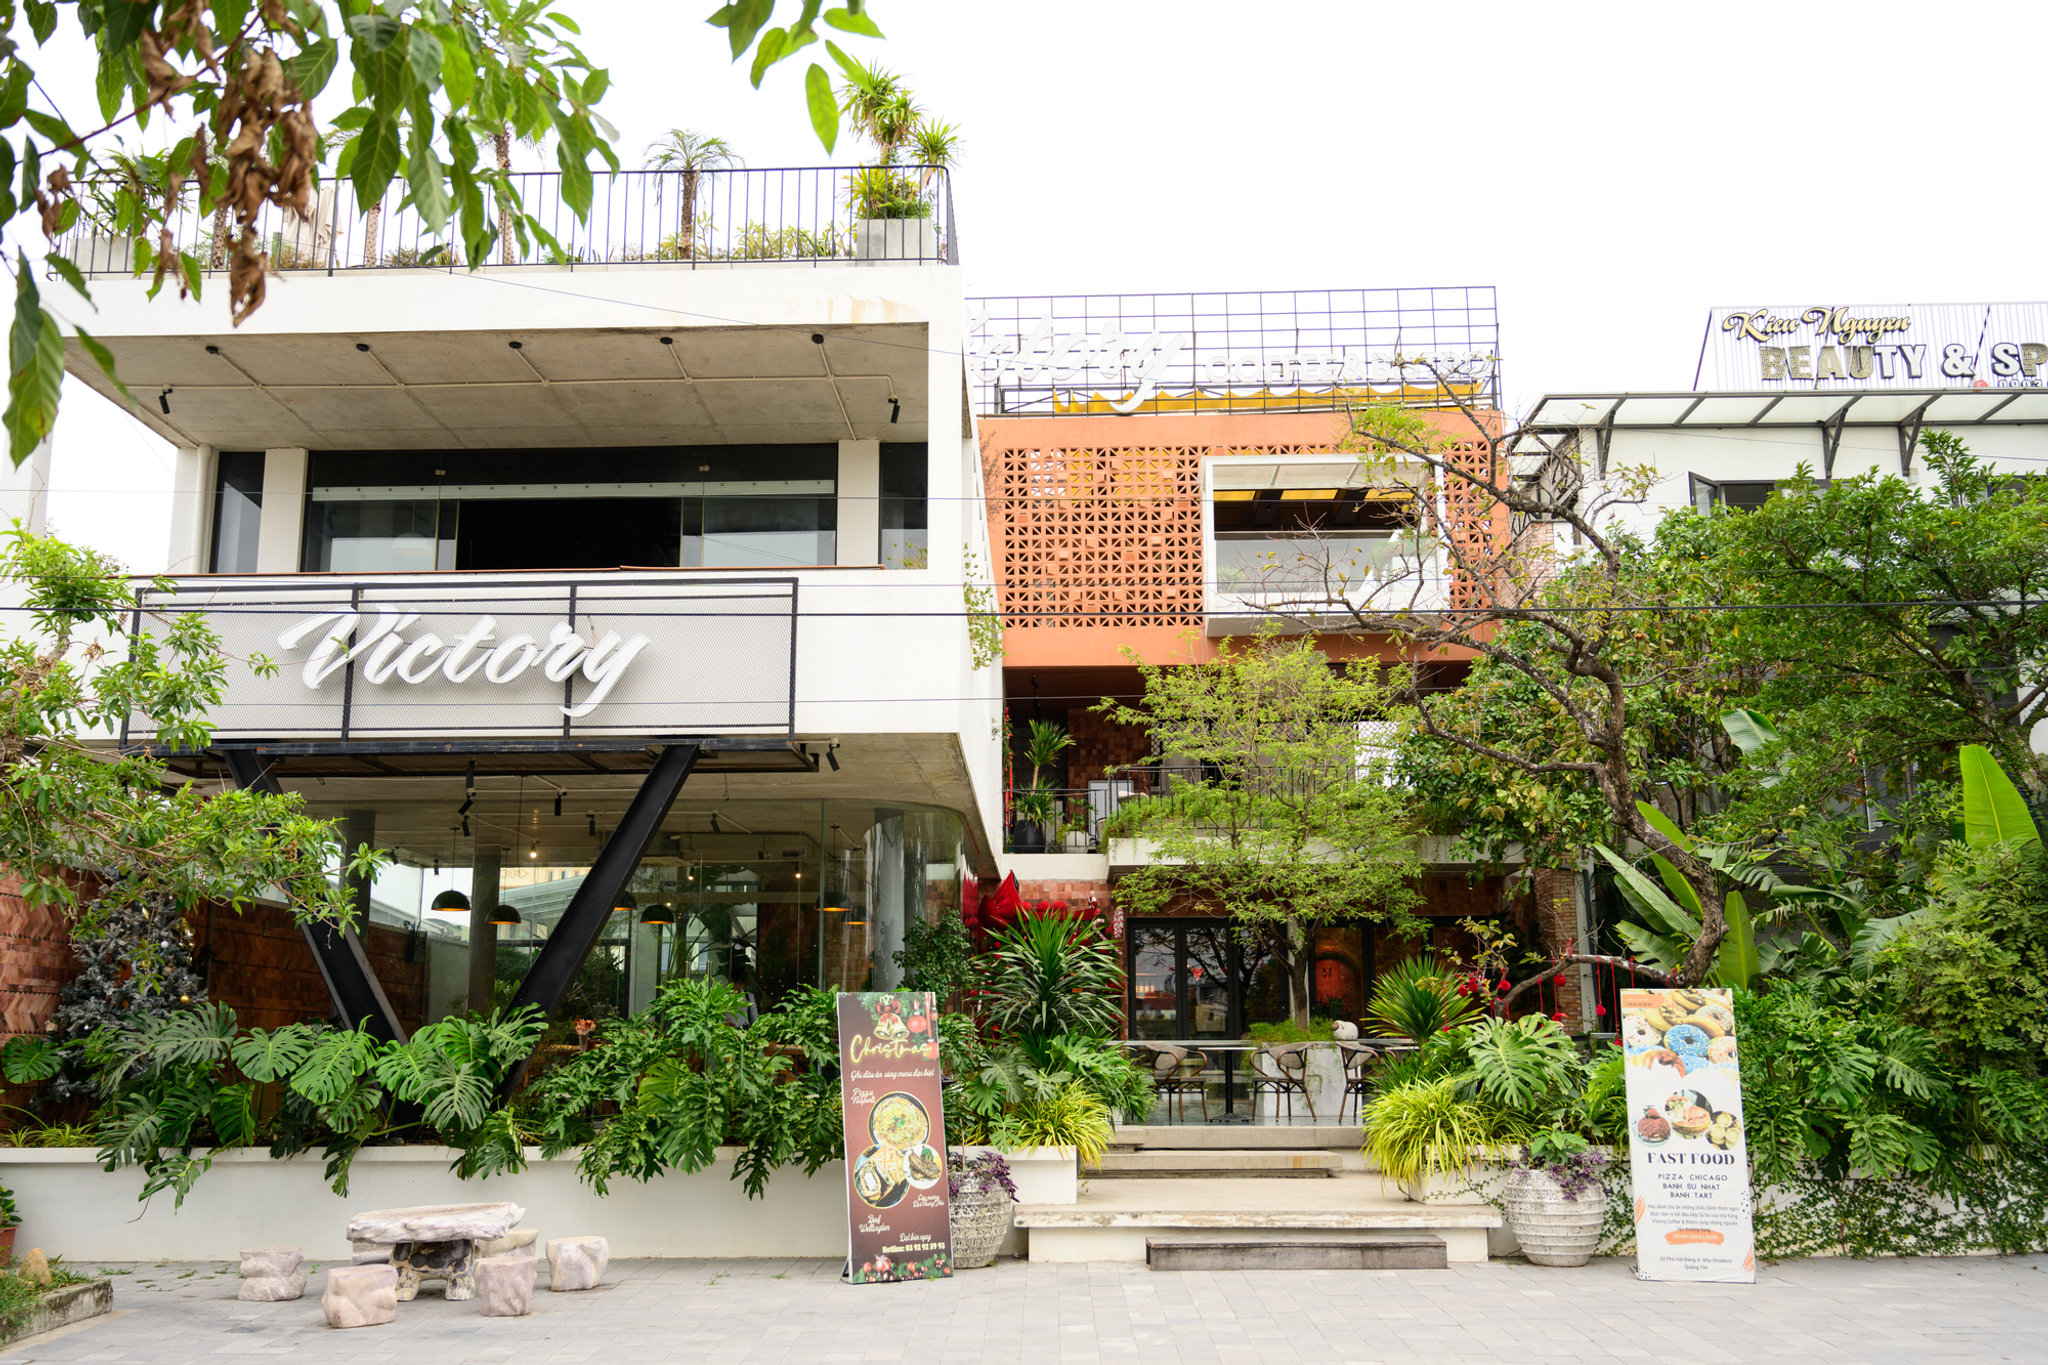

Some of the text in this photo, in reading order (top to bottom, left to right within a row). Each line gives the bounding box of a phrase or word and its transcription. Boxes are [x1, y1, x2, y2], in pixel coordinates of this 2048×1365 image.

[1801, 306, 1911, 345] Nguyen
[1205, 353, 1338, 384] COFFEE
[1342, 352, 1366, 382] &
[1759, 344, 1927, 381] BEAUTY
[1941, 343, 1976, 377] &
[277, 603, 651, 718] Victory
[1647, 1152, 1735, 1165] FAST FOOD
